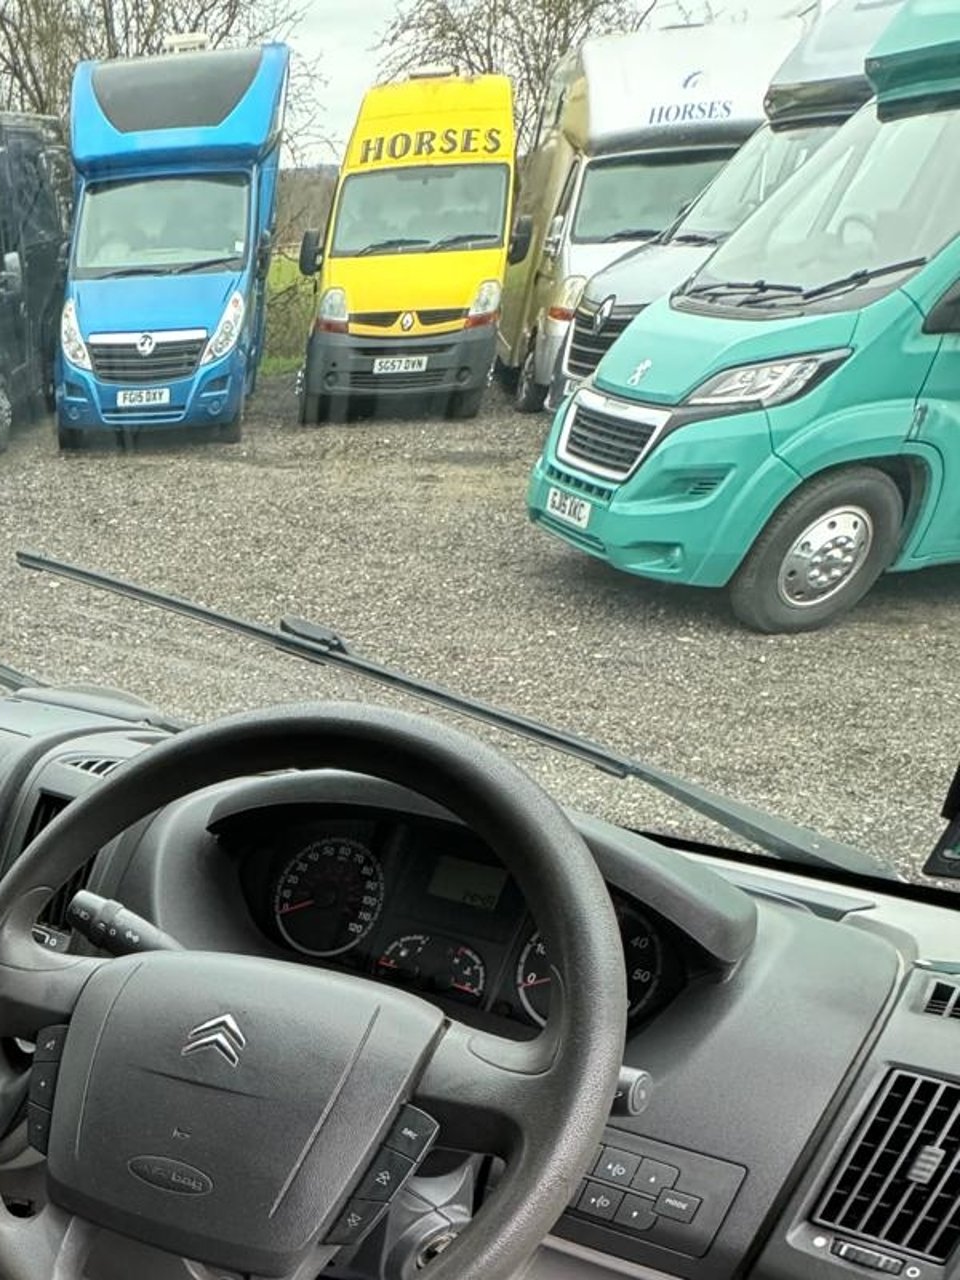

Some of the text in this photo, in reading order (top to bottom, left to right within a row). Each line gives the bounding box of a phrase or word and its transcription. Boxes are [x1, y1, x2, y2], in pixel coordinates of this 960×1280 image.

[648, 100, 734, 124] HORSES
[360, 127, 502, 164] HORSES
[145, 390, 164, 402] DXY
[631, 935, 649, 949] 40
[527, 972, 537, 984] 0
[632, 968, 651, 983] 50
